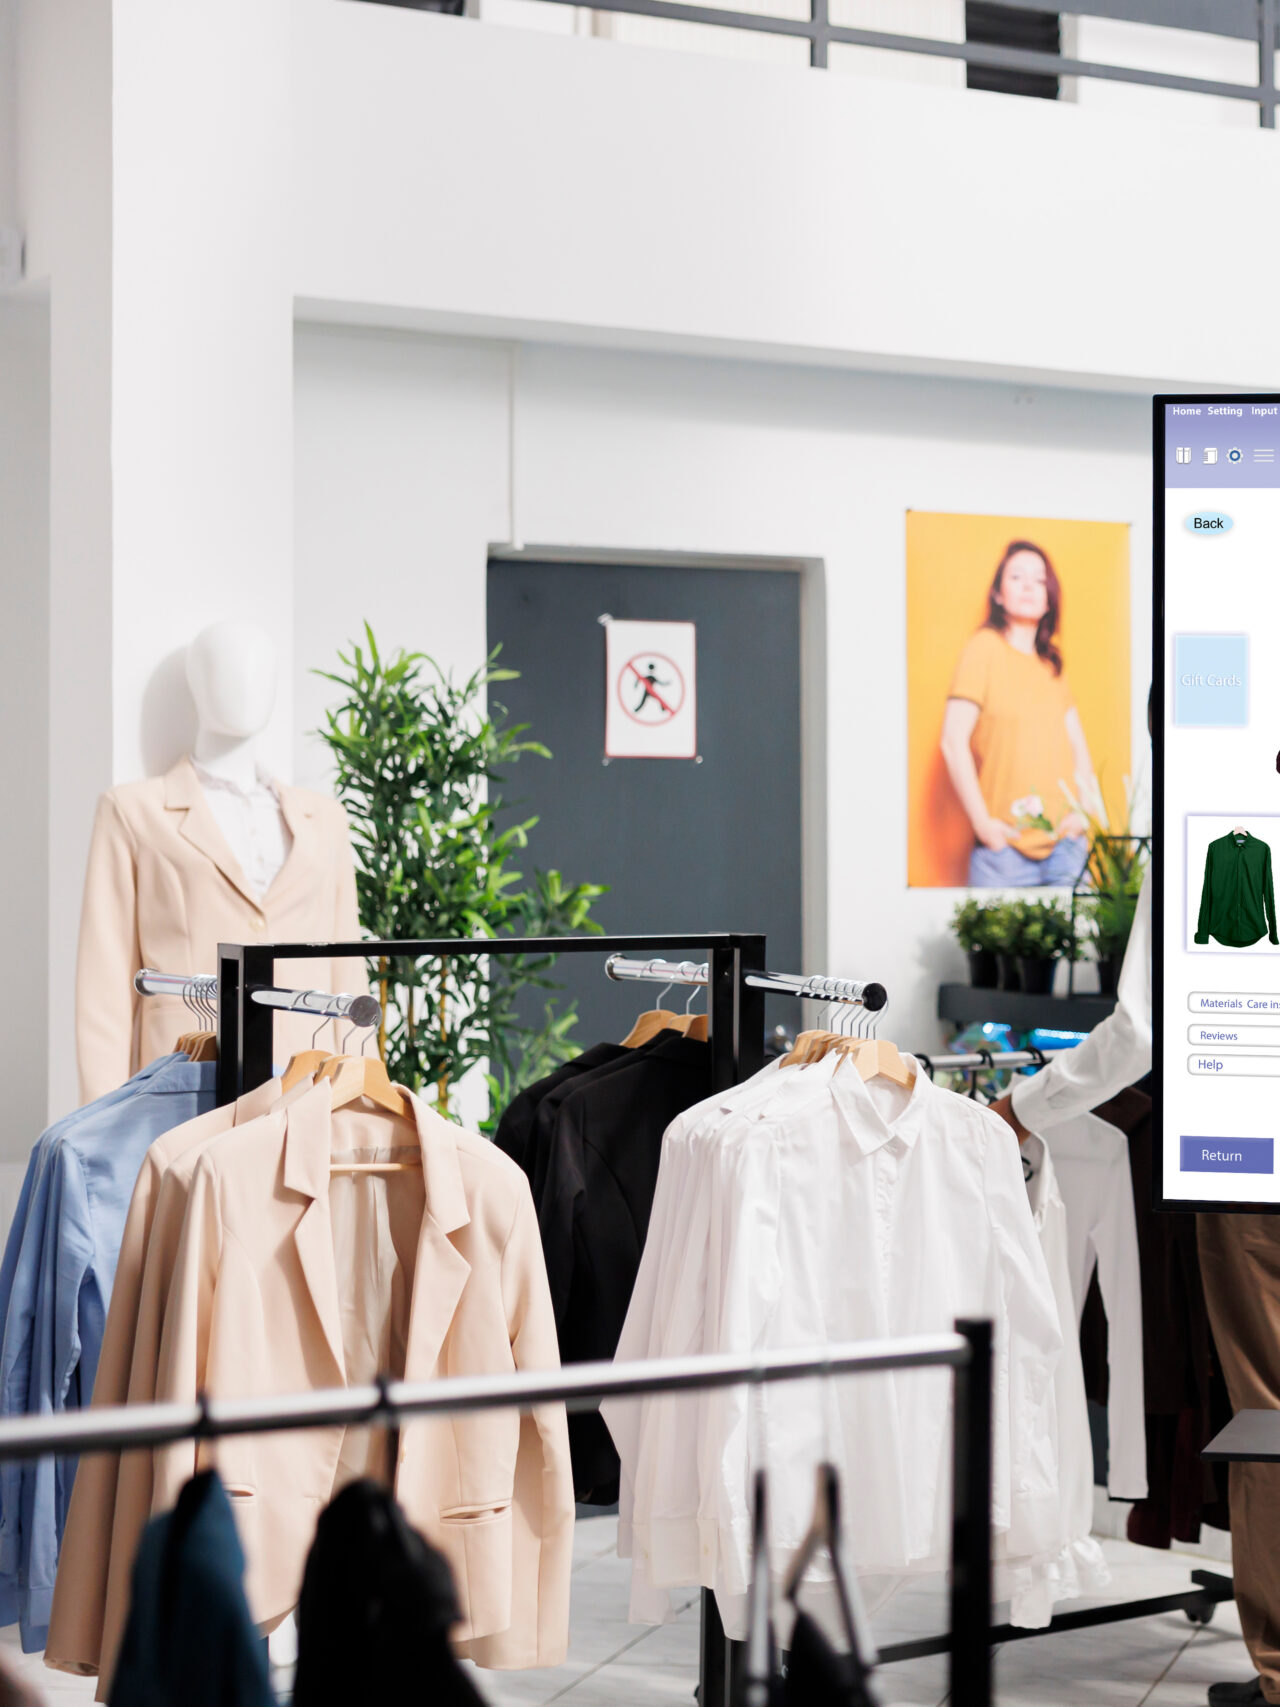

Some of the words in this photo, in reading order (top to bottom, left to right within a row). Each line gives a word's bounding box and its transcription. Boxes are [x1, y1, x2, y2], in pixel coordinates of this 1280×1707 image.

[1172, 406, 1202, 416] Home
[1207, 406, 1243, 417] Setting
[1251, 406, 1278, 417] Input
[1193, 517, 1224, 529] Back
[1181, 672, 1203, 687] Gift
[1206, 673, 1242, 687] Cards
[1200, 998, 1243, 1009] Materials
[1246, 999, 1268, 1009] Care
[1200, 1031, 1238, 1041] Reviews
[1198, 1059, 1224, 1071] Help
[1201, 1149, 1243, 1162] Return
